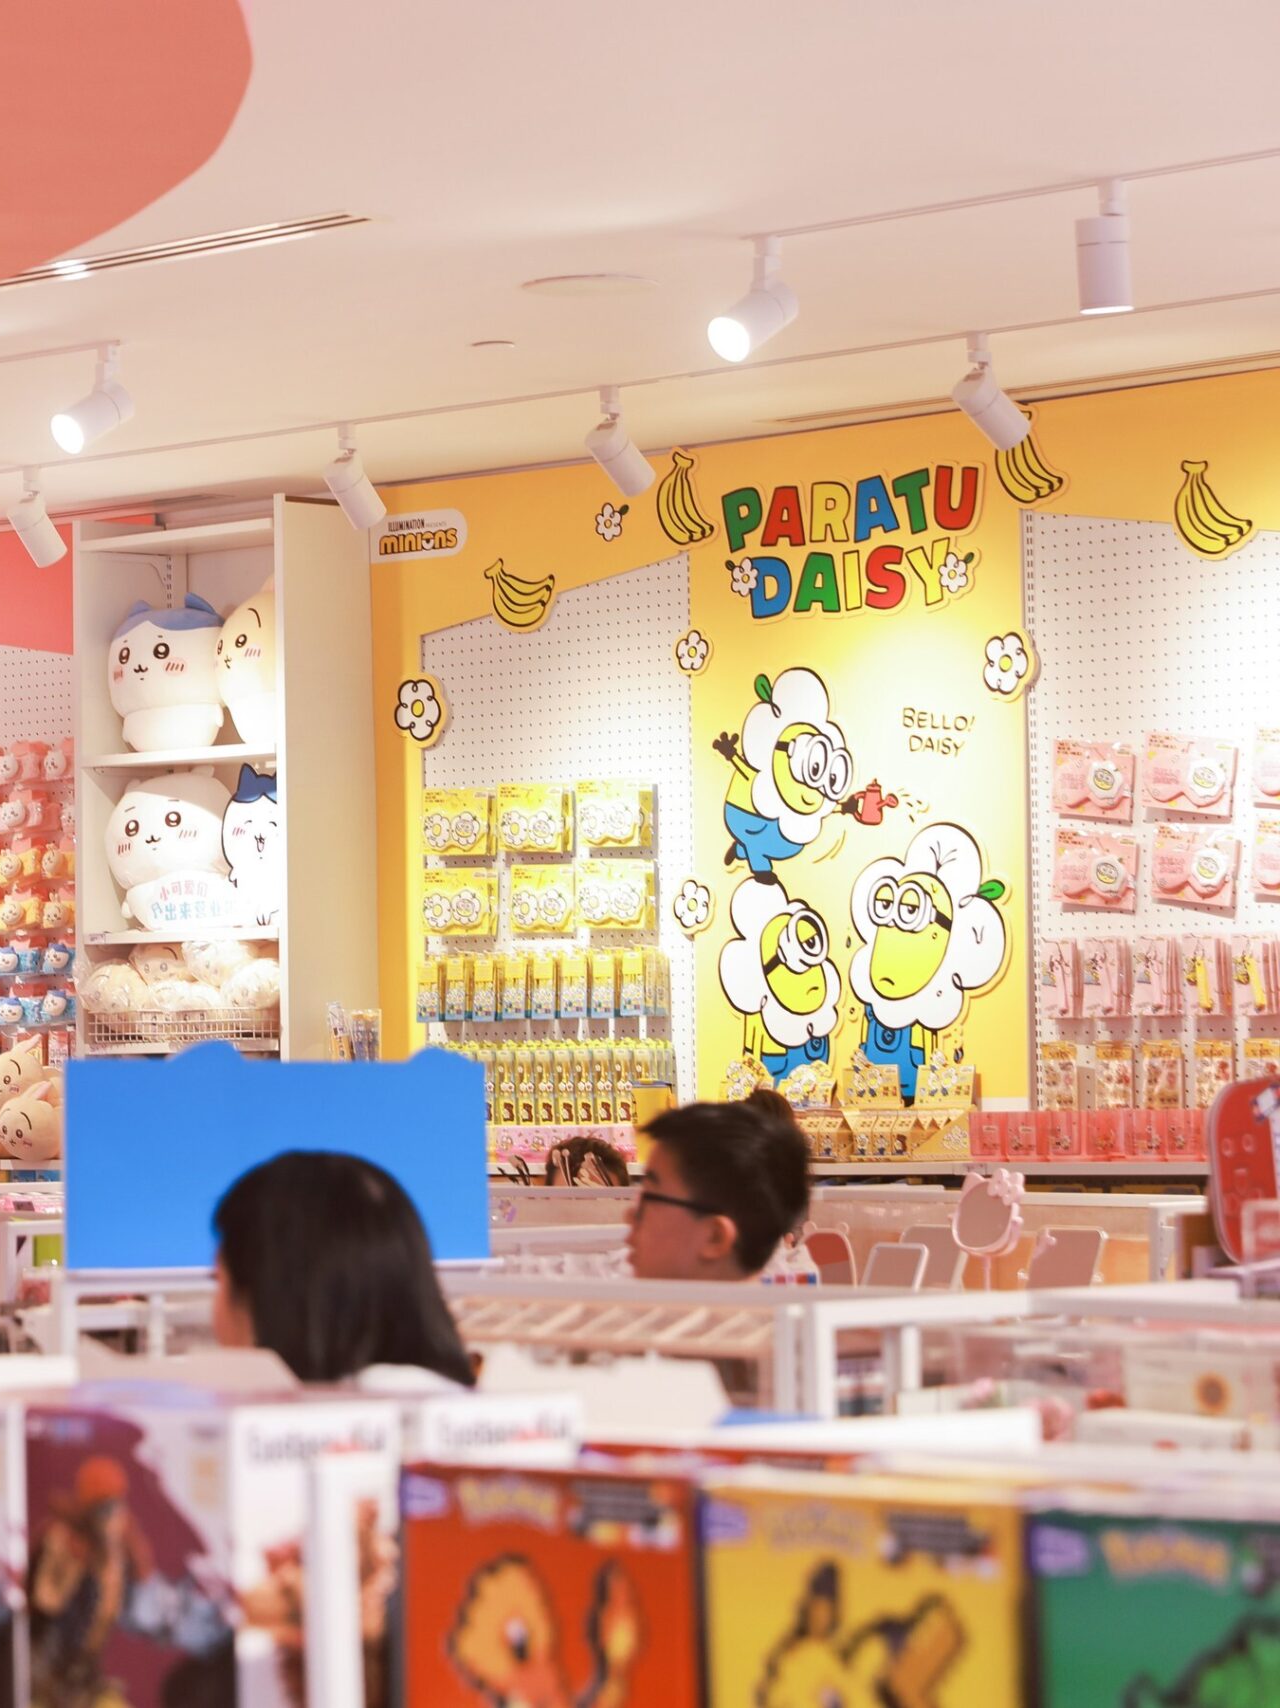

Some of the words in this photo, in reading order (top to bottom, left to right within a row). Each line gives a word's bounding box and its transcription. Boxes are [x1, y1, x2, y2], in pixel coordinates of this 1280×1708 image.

[721, 465, 979, 553] PARATU
[387, 518, 425, 532] ILLUMINATION
[748, 537, 951, 619] DAISY
[902, 706, 976, 732] BELLO!
[908, 734, 965, 758] DAISY
